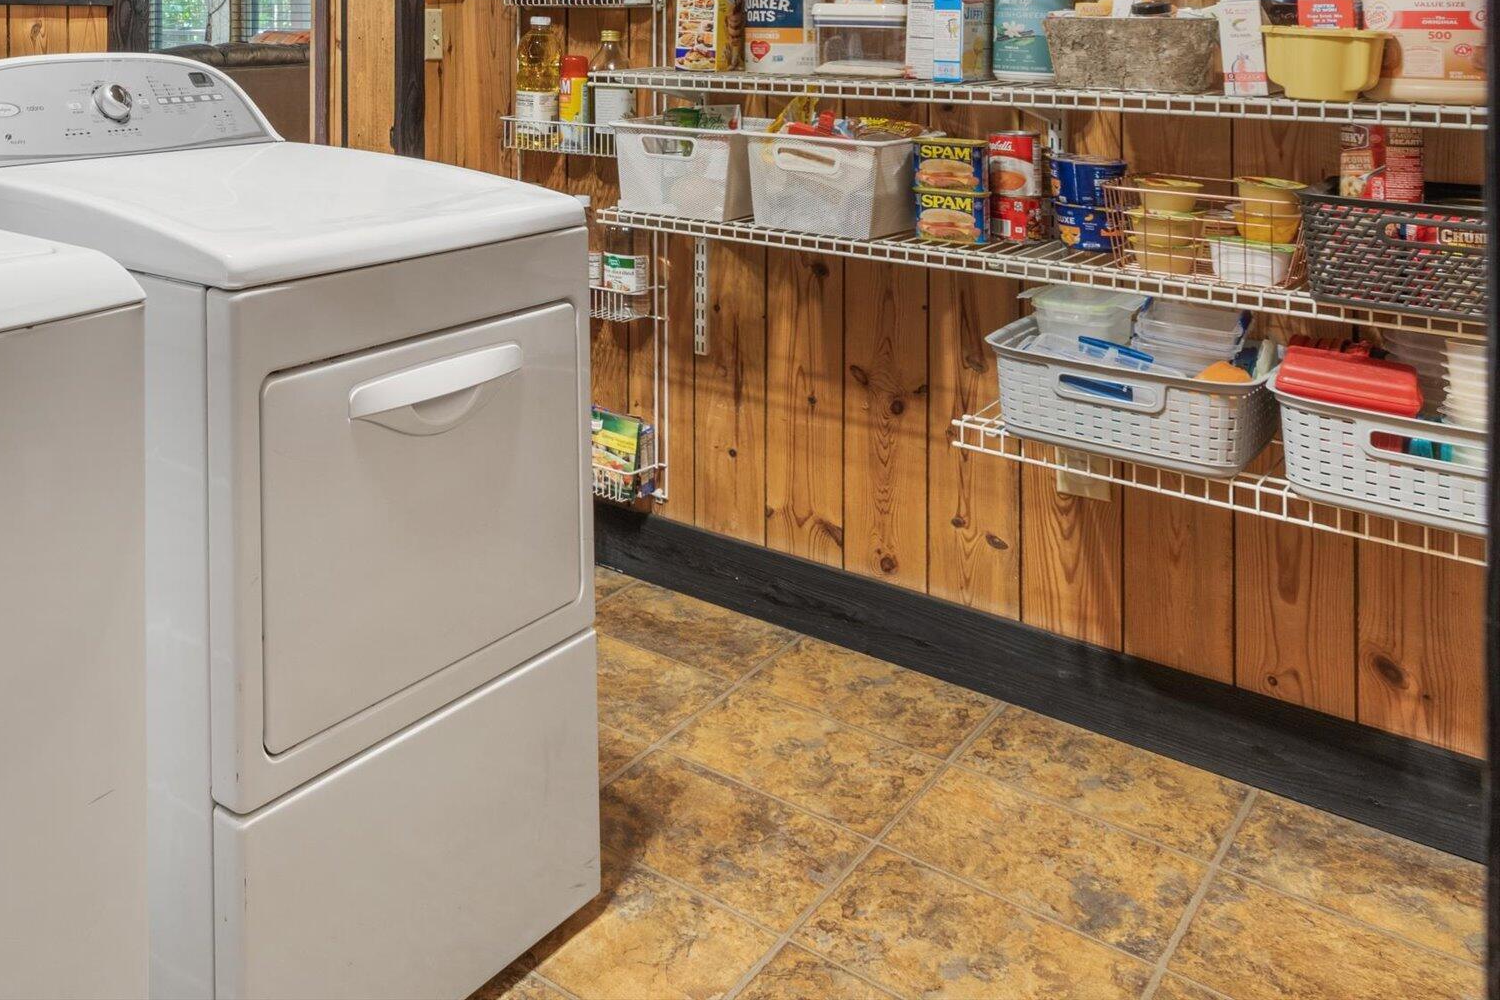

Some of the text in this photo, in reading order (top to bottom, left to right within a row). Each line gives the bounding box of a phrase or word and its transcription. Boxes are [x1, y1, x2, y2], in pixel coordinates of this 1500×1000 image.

[746, 10, 776, 22] OATS
[1428, 31, 1452, 40] 500
[920, 144, 972, 161] SPAM
[921, 194, 974, 211] SPAM
[1440, 229, 1488, 244] CHUN
